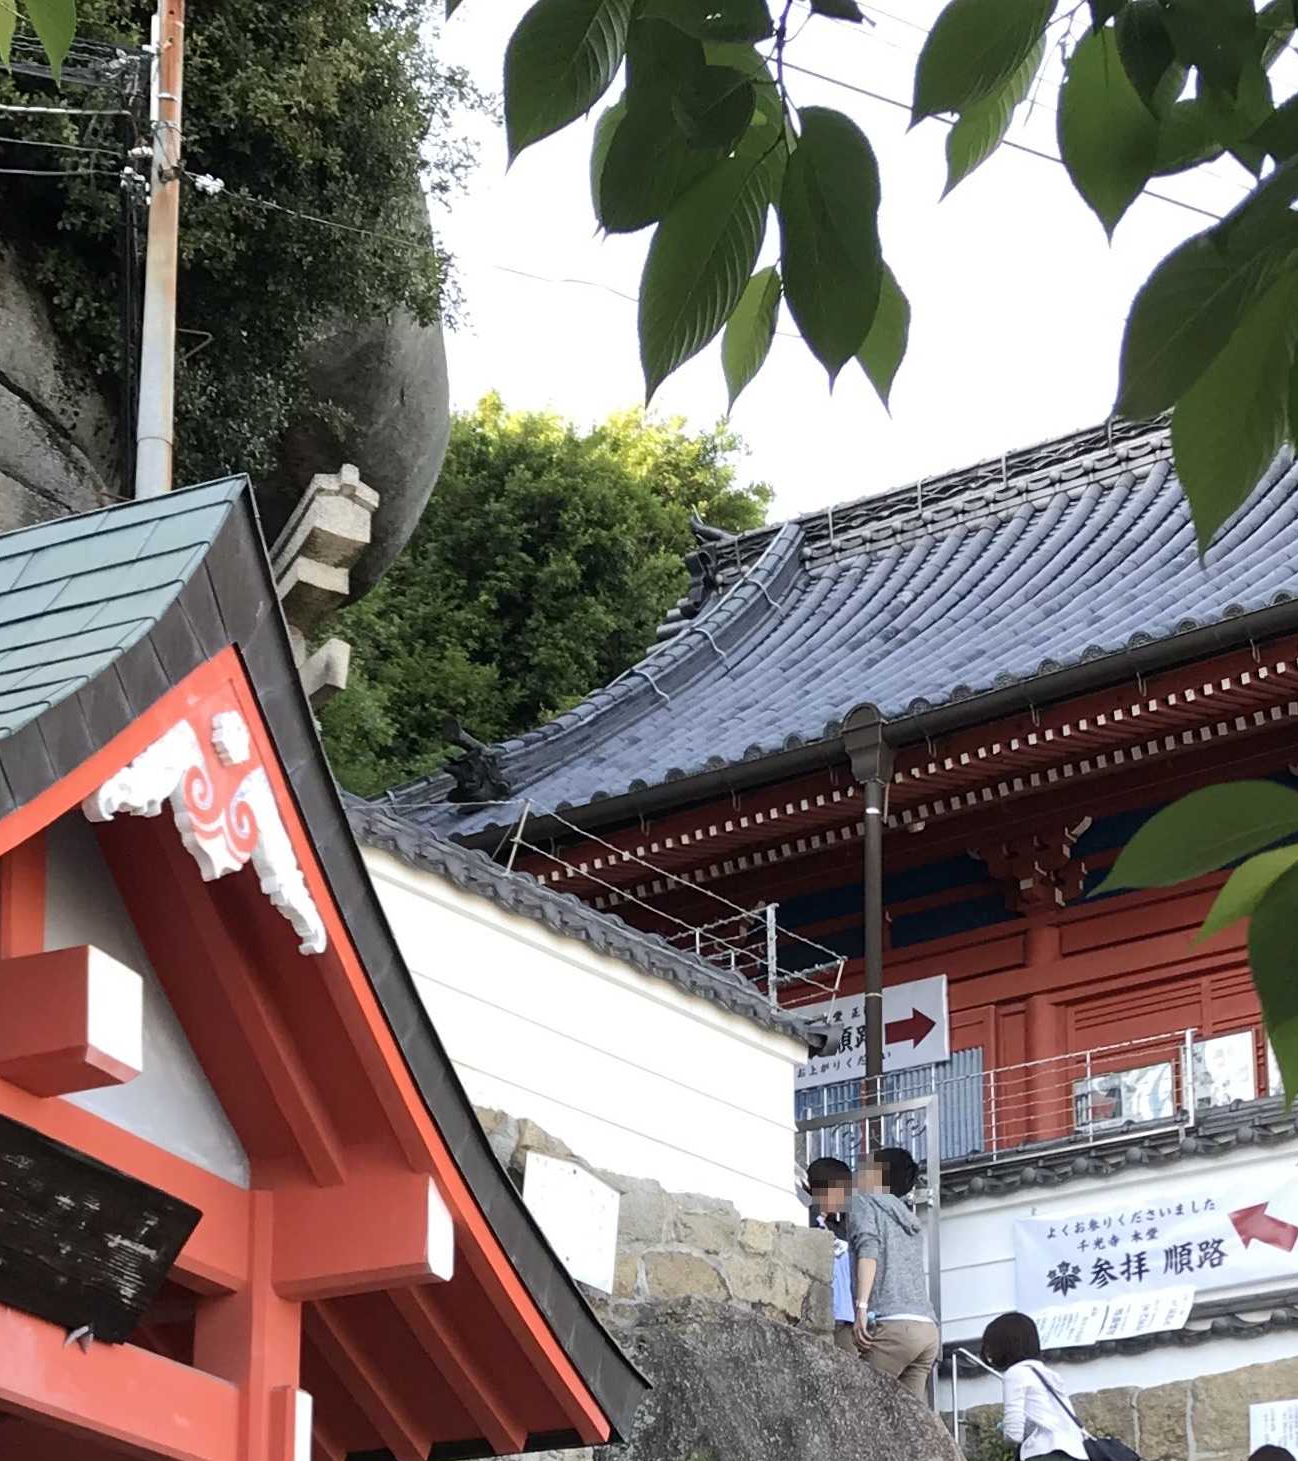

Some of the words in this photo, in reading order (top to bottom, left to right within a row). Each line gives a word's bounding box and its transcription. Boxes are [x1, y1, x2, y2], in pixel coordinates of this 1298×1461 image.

[1047, 1198, 1217, 1239] よくお参りくださいました
[1076, 1235, 1120, 1253] 千光寺
[1131, 1226, 1160, 1243] 本堂
[1088, 1250, 1151, 1290] 参拝
[1163, 1237, 1229, 1275] 順路
